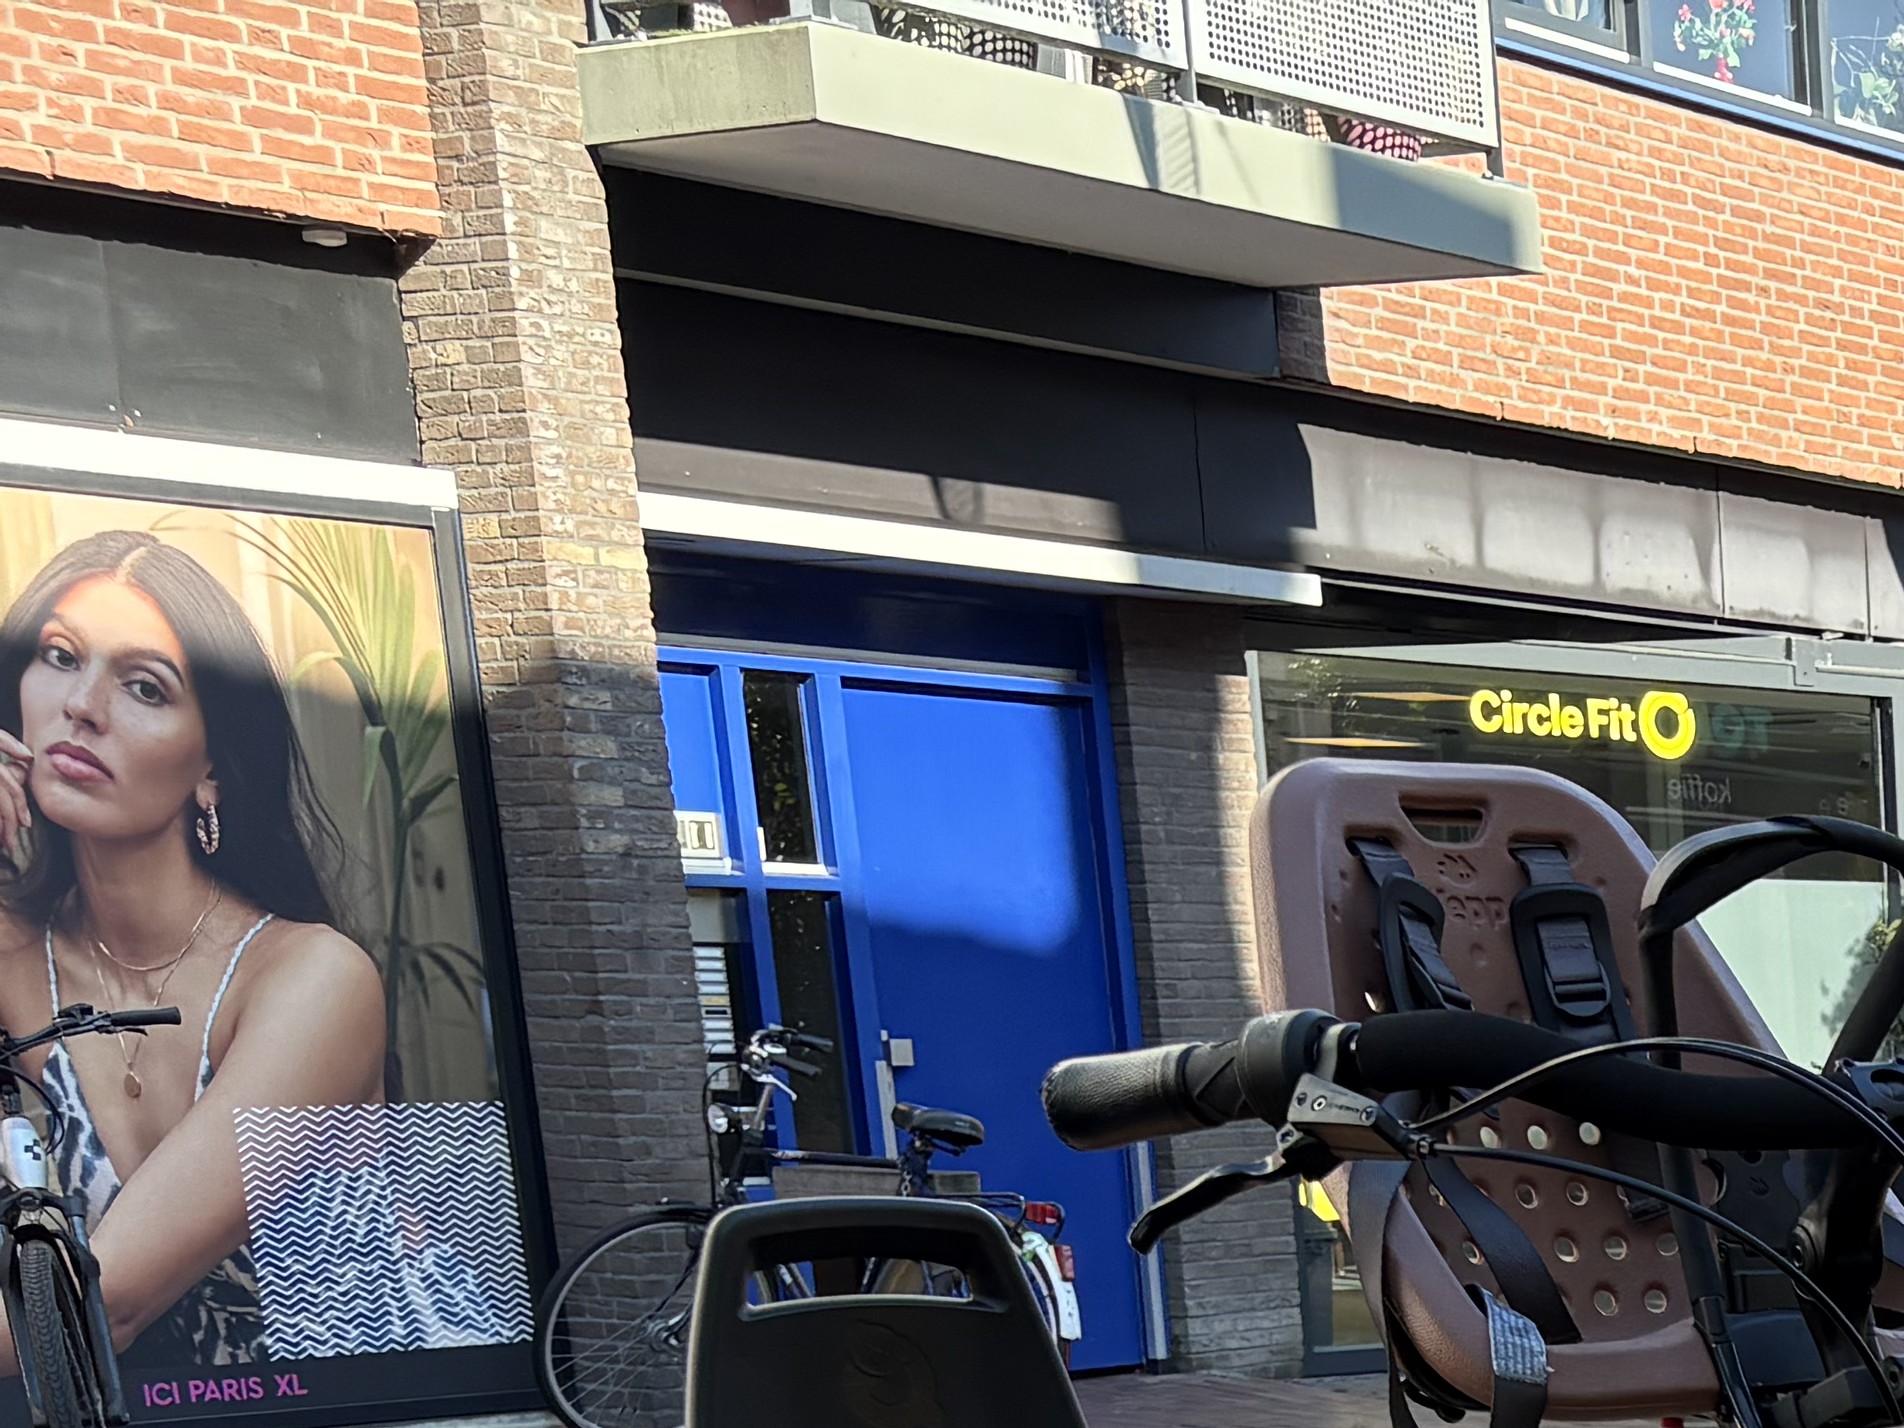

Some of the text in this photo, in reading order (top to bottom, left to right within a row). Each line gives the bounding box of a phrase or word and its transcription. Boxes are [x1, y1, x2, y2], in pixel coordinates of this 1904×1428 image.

[143, 1373, 309, 1407] ICI PARIS XL
